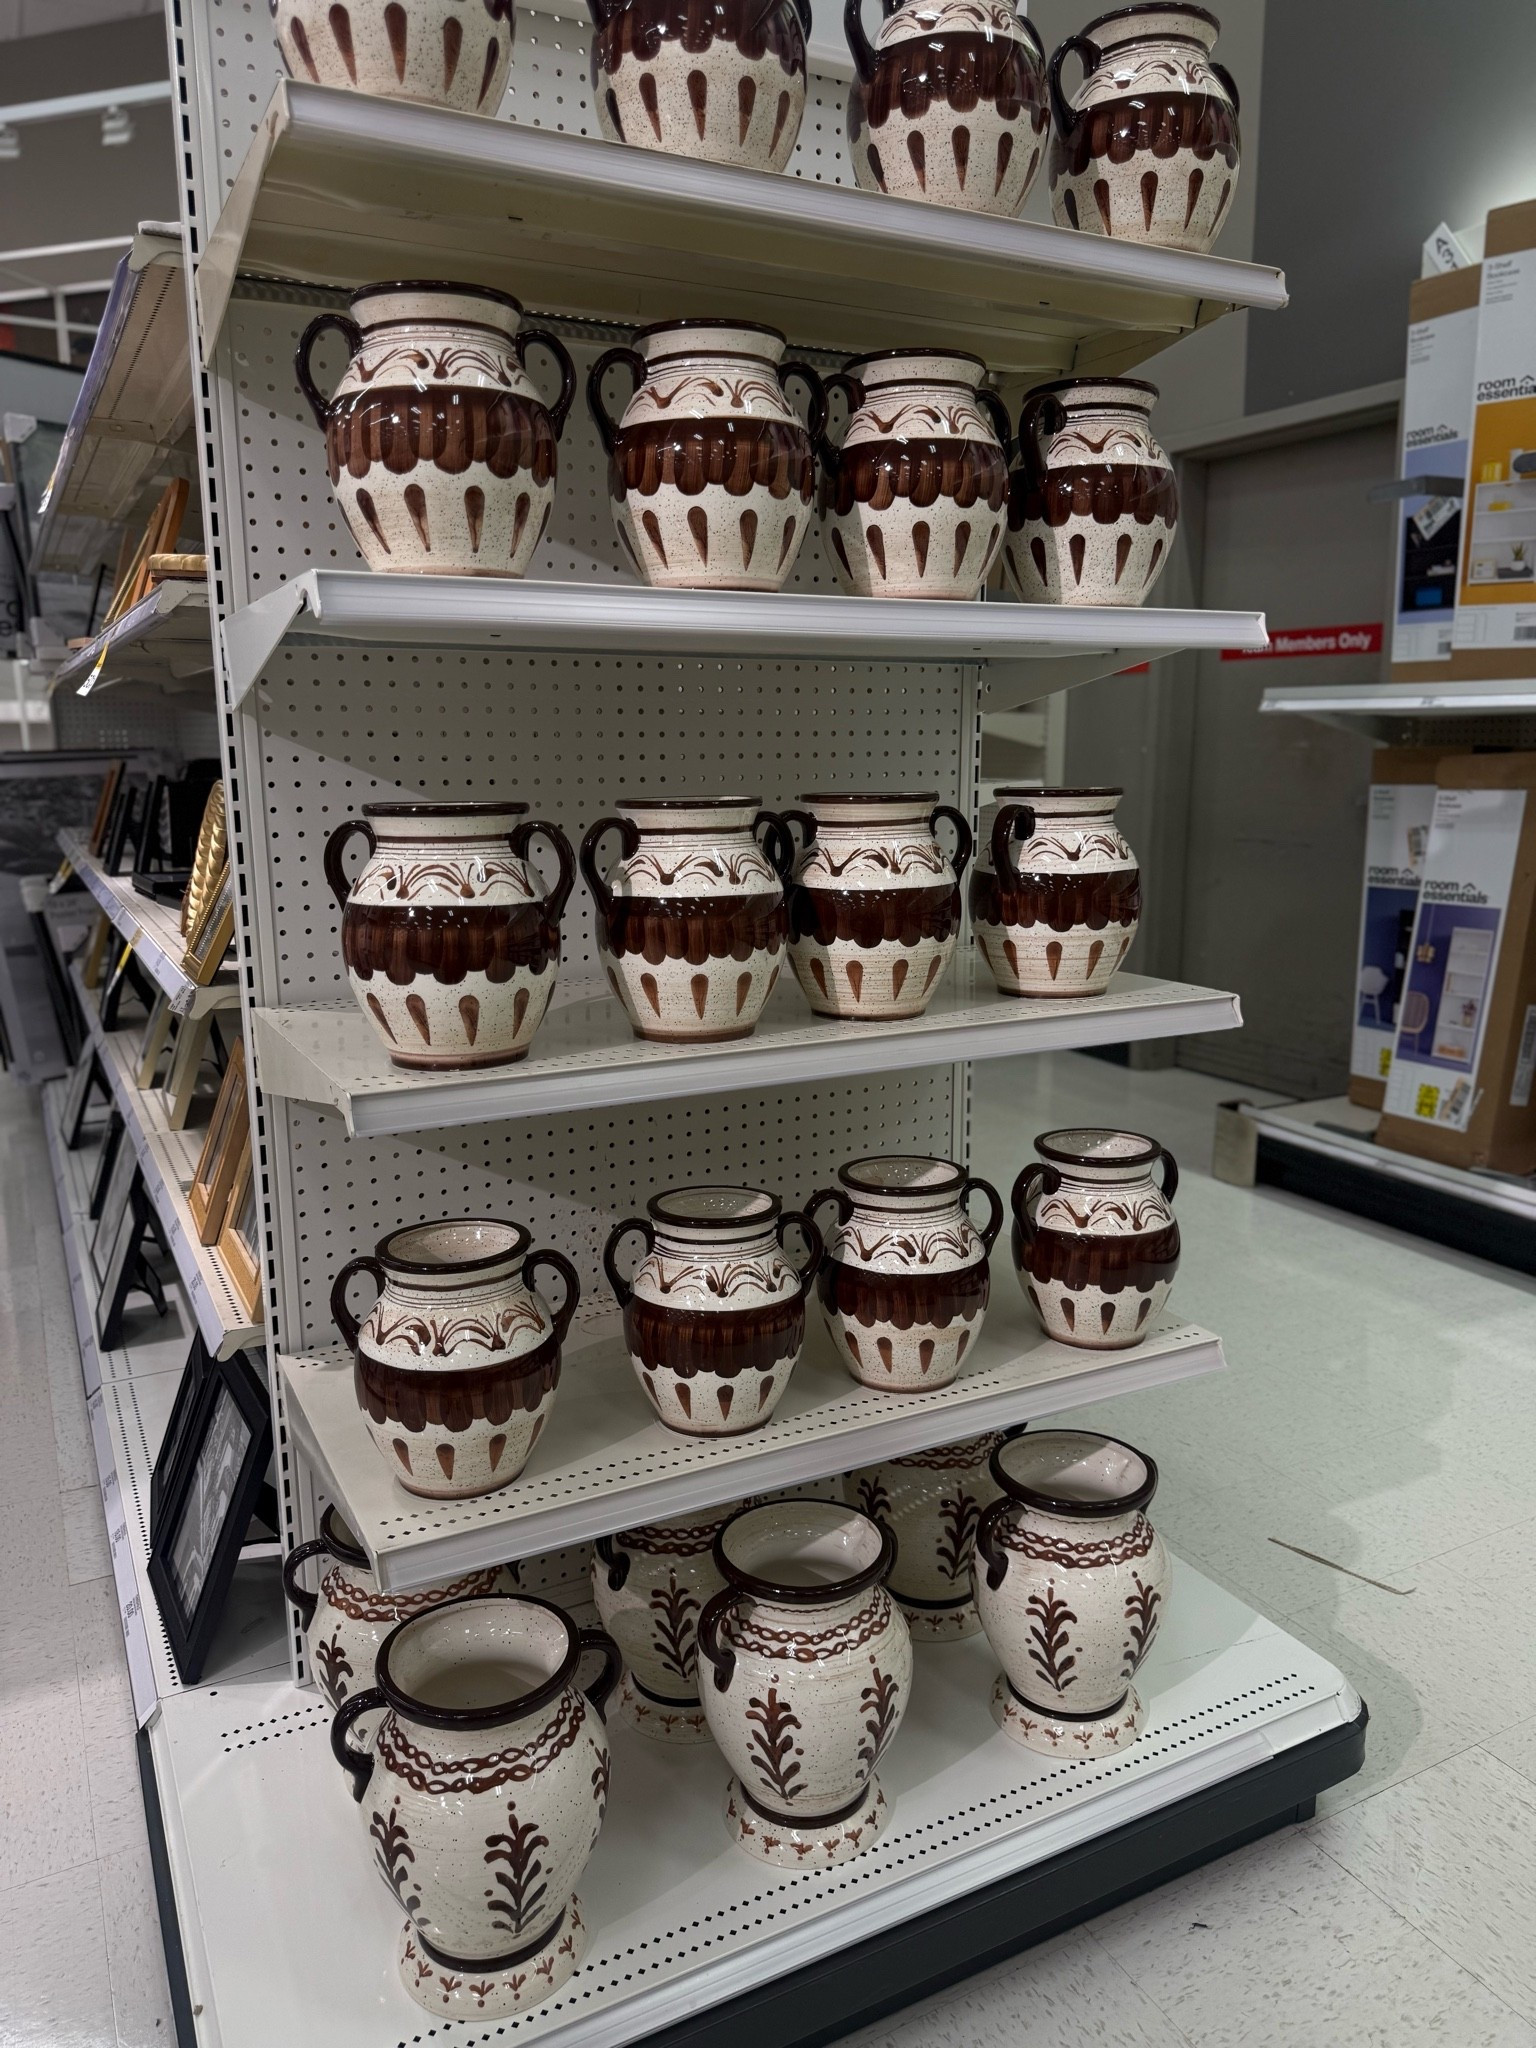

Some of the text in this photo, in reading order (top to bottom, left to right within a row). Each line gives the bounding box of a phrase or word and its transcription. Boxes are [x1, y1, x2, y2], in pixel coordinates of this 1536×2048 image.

[1477, 377, 1516, 392] room
[1406, 427, 1435, 441] room
[1406, 429, 1459, 449] essentials
[1275, 636, 1336, 651] Members
[1338, 632, 1372, 650] Only
[1368, 866, 1399, 876] room
[1424, 879, 1460, 892] room
[1423, 890, 1488, 905] essentials
